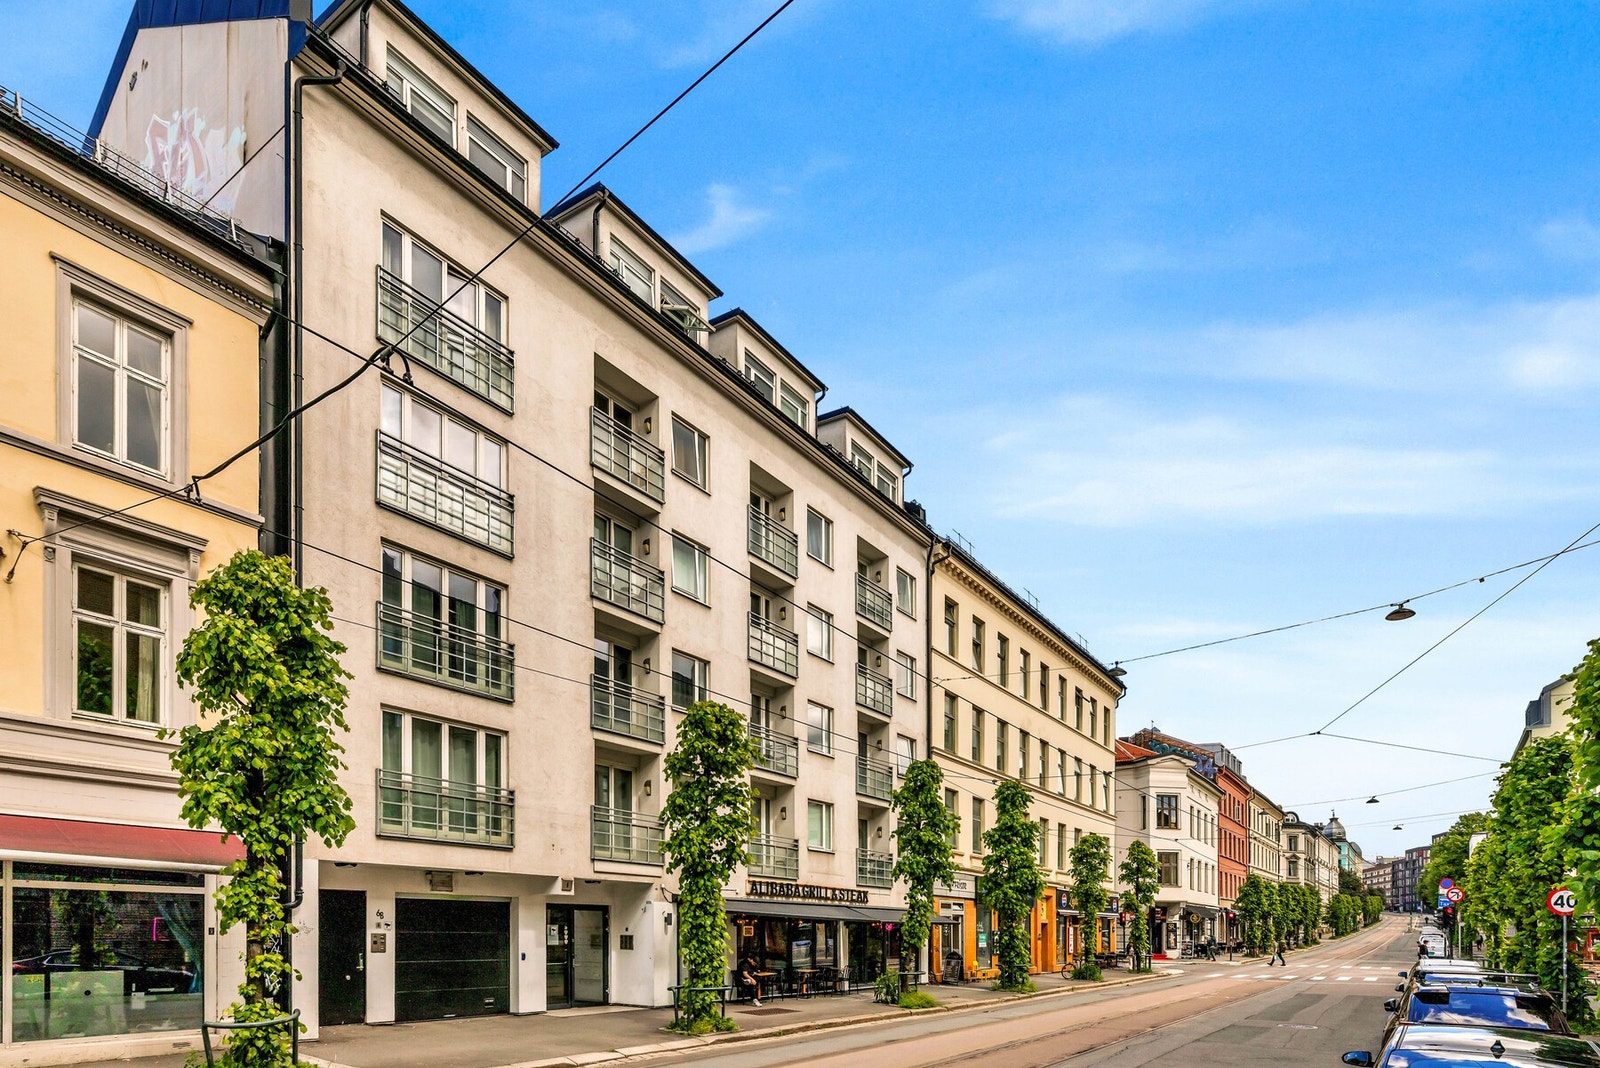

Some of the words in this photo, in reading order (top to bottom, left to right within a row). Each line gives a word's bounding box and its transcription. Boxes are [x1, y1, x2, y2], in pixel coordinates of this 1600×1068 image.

[750, 880, 801, 897] ALIBABA
[801, 885, 830, 899] GRILL
[831, 887, 839, 900] &
[839, 888, 869, 903] STEAK
[1553, 895, 1578, 908] 40
[376, 909, 384, 919] 68
